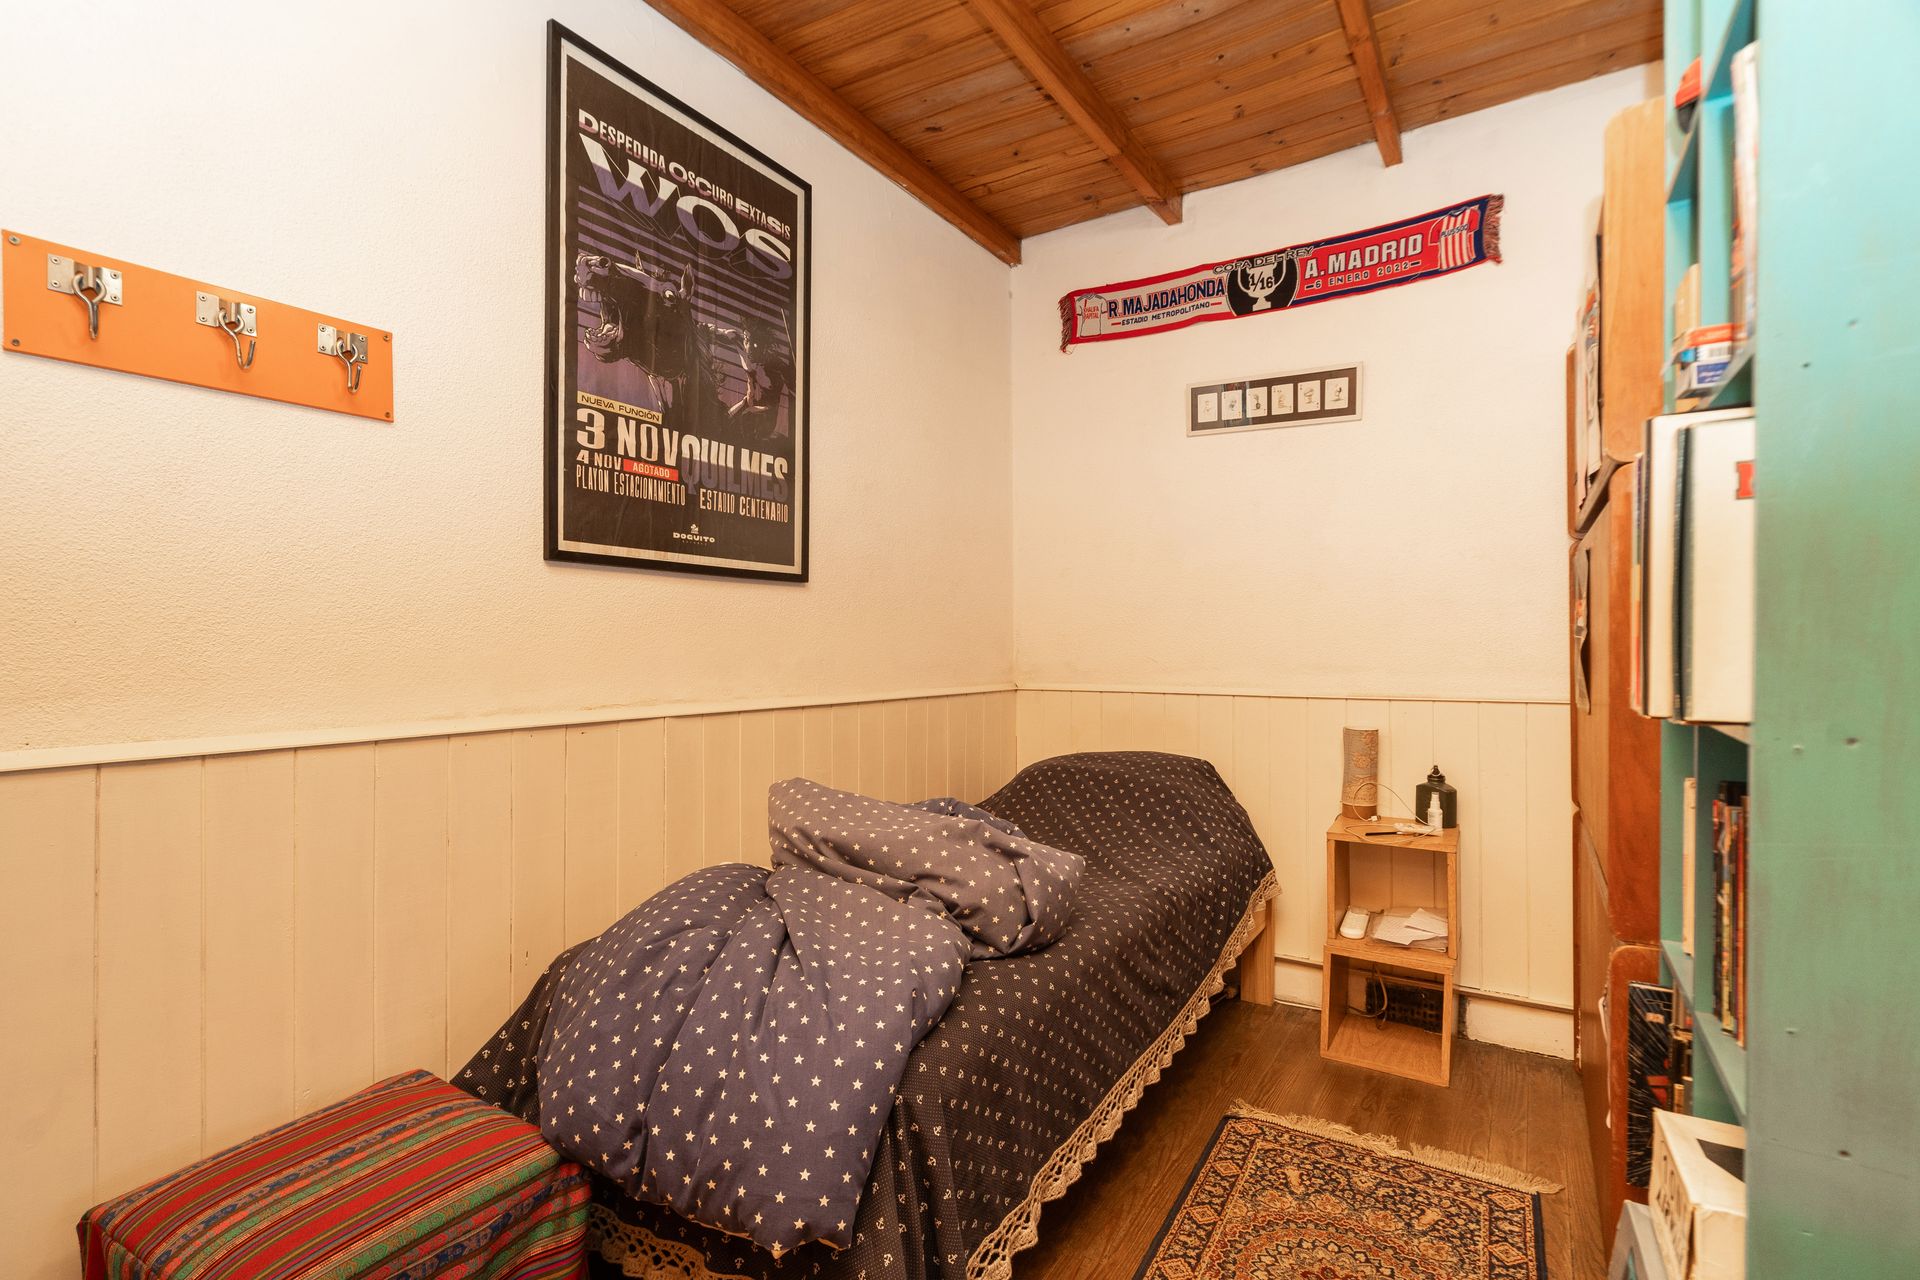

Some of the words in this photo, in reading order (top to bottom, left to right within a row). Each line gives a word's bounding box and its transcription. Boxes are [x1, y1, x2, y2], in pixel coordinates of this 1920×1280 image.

[578, 108, 666, 173] DESPEDIDA
[668, 161, 734, 210] OSCURO
[735, 197, 791, 241] EXTASIS
[579, 132, 793, 280] WOS
[1213, 260, 1252, 275] COPA
[1253, 254, 1283, 268] DEL
[1286, 246, 1315, 260] REY
[1249, 271, 1275, 292] 1/16
[1315, 280, 1322, 289] 6
[1328, 271, 1370, 286] ENERO
[1377, 261, 1410, 276] 2022
[1121, 315, 1149, 326] ESTADIO
[1151, 301, 1211, 321] METROPOLITANO
[581, 394, 615, 410] NUEVA
[618, 403, 660, 422] FUNCIÓN
[576, 407, 605, 450] 3
[617, 416, 680, 467] NOV
[576, 450, 589, 464] 4
[593, 452, 623, 471] NOV
[632, 462, 670, 479] AGOTADO
[681, 434, 789, 502] QUILMES
[576, 464, 609, 494] PLAYON
[614, 473, 686, 506] ESTACIONAMIENTO
[699, 487, 735, 514] ESTADIO
[739, 498, 789, 523] CENTENARIO
[672, 532, 716, 543] DOGUITO
